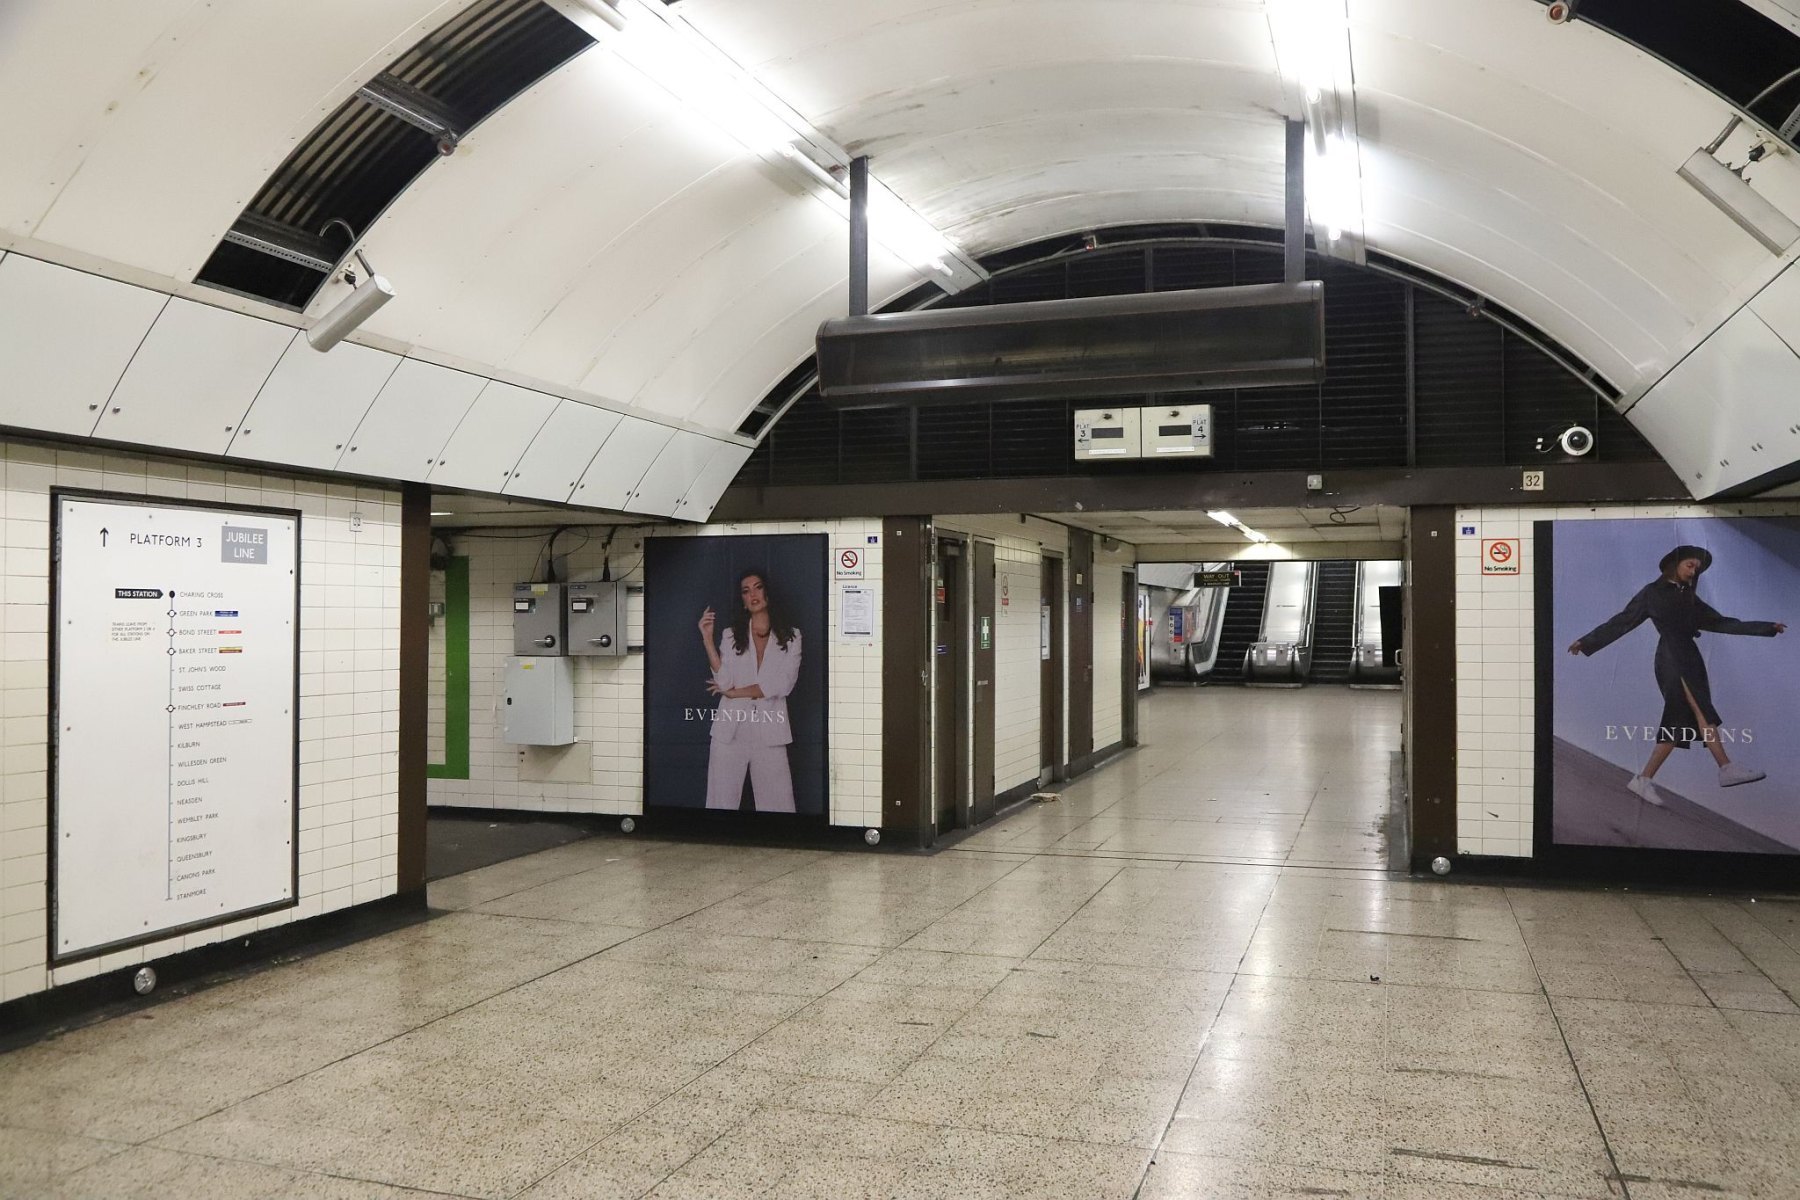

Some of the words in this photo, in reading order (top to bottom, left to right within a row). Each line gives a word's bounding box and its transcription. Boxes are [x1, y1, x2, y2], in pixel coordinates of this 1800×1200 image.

[1080, 430, 1086, 438] 3
[1525, 475, 1540, 487] 32
[130, 533, 191, 547] PLATFORM
[196, 538, 202, 548] 3
[226, 531, 264, 544] JUBILEE
[233, 547, 255, 559] LINE
[132, 590, 158, 598] STATION
[177, 703, 205, 711] FINCHLEY
[684, 708, 785, 723] EVENDENS
[178, 722, 193, 730] WEST
[195, 720, 227, 729] HAMPSTEAD
[1605, 725, 1753, 744] EVENDENS
[177, 741, 201, 749] KILBURN
[177, 759, 208, 767] WILLESDEN
[177, 778, 195, 787] DOLLIS
[176, 796, 203, 806] NEASDEN
[177, 815, 203, 824] WEMBLEY
[205, 812, 219, 820] PARK
[176, 833, 207, 843] KINGSBURY
[176, 850, 213, 863] QUEENSBURY
[176, 871, 200, 882] CANONS
[202, 868, 216, 877] PARK
[176, 888, 207, 901] STANMORE
